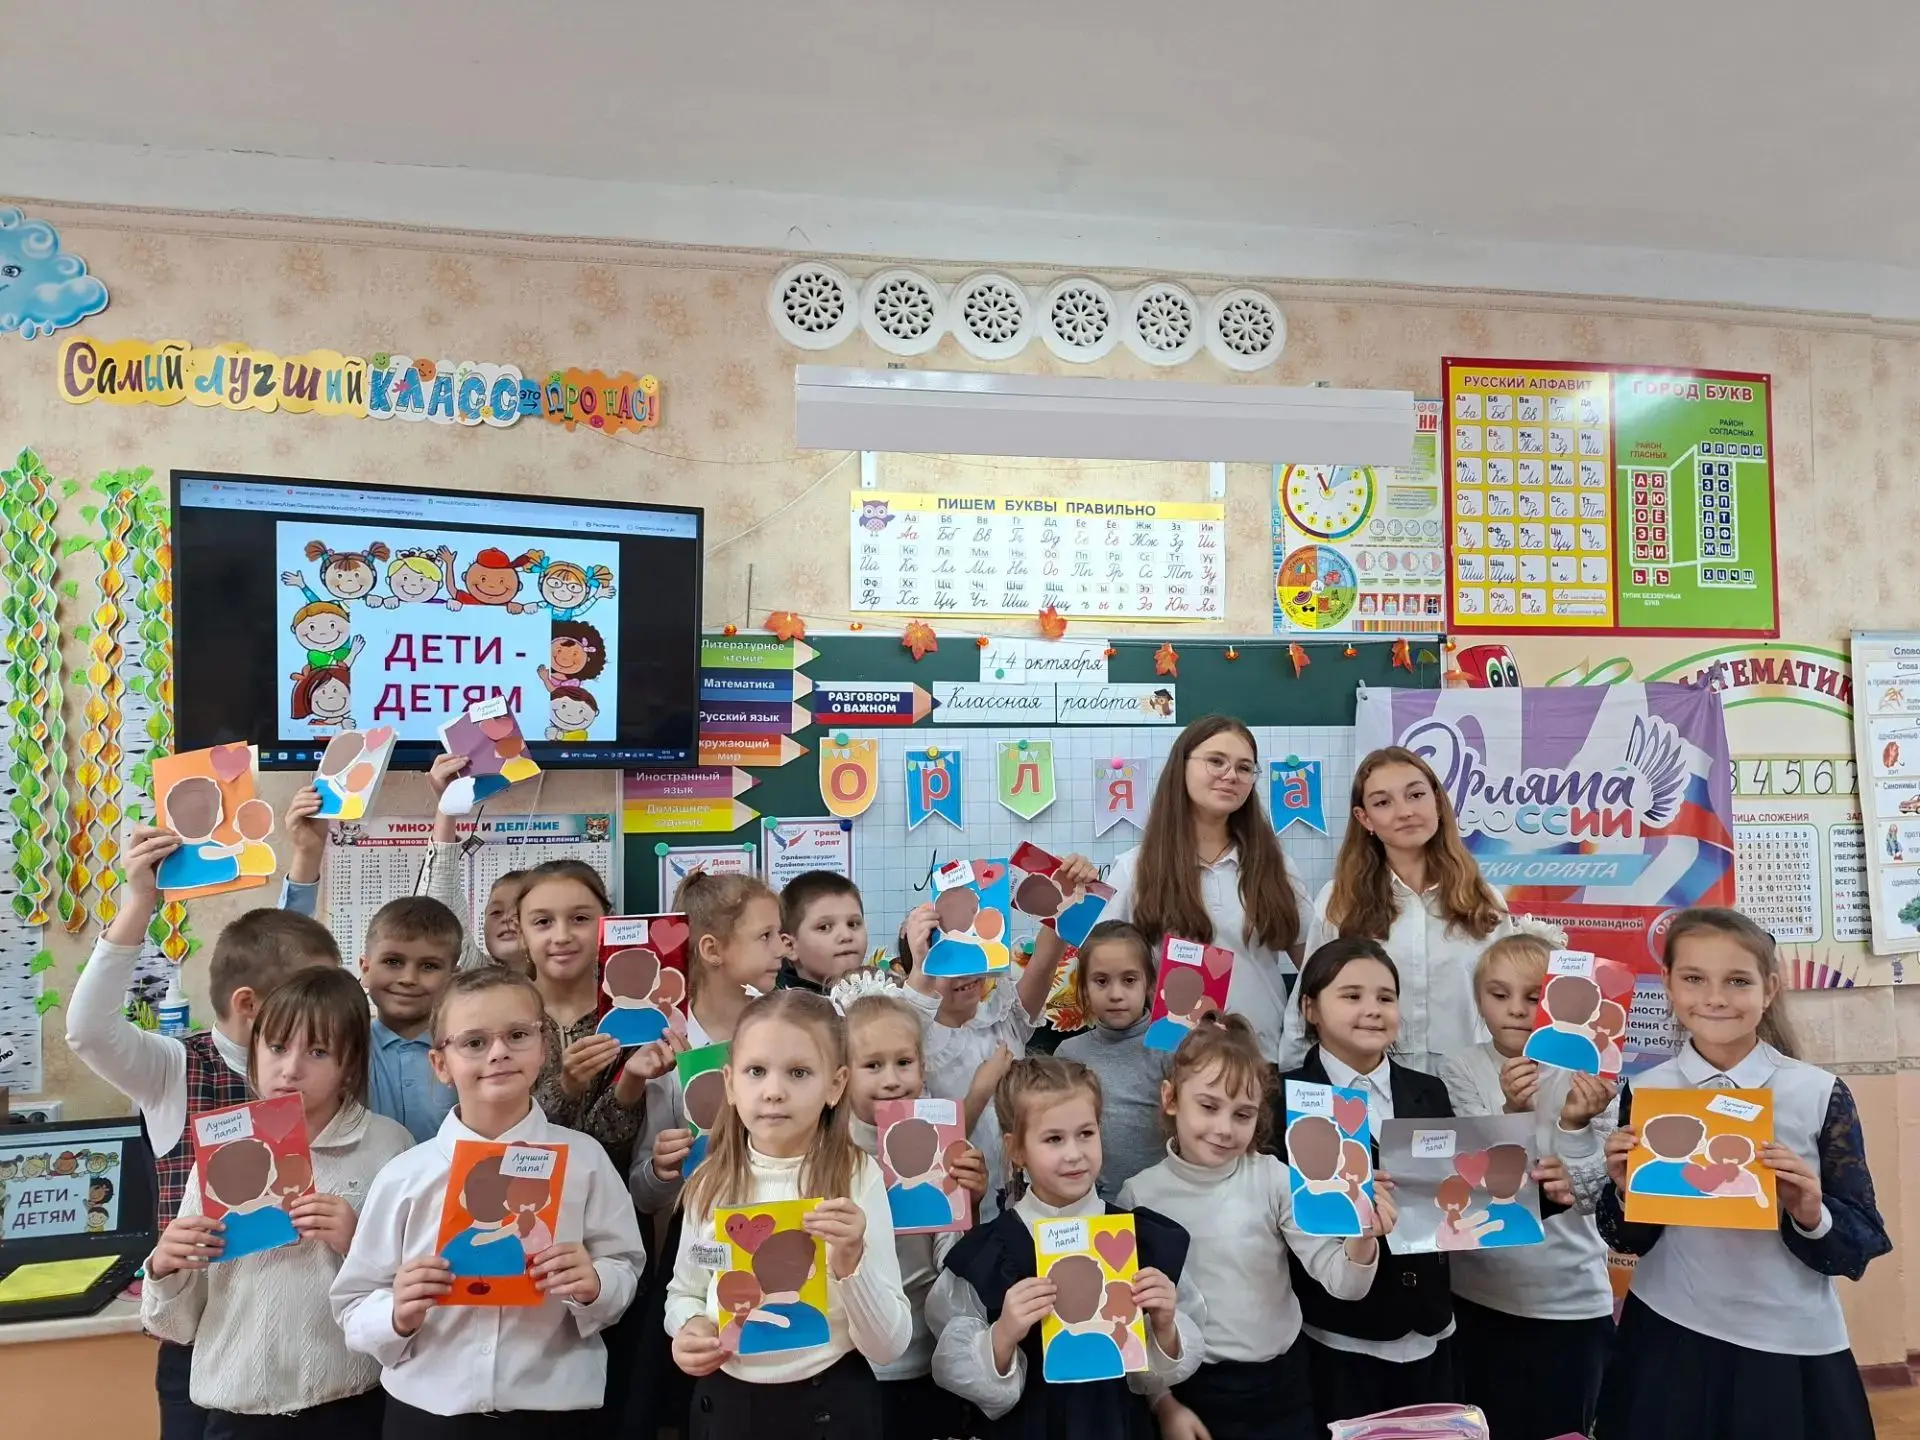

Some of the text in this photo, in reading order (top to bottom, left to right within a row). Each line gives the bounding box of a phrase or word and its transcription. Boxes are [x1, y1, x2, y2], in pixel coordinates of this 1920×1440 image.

[64, 342, 185, 397] Самый
[1464, 375, 1592, 390] РУССКИЙ АЛФАВИТ
[369, 367, 518, 421] КЛАСС
[1634, 382, 1752, 400] ГОРОД БУКВ
[545, 384, 654, 421] ПРО НАС!
[1719, 418, 1743, 427] РАЙОН
[1709, 427, 1754, 436] СОГЛАСНЫХ
[1636, 441, 1662, 450] РАЙОН
[1631, 450, 1667, 459] ГЛАСНЫХ
[938, 498, 1156, 517] ПИШЕМ БУКВЫ ПРАВИЛЬНО
[701, 639, 785, 651] Литературное
[385, 634, 502, 671] ДЕТИ
[723, 655, 763, 663] чтение
[1025, 650, 1104, 678] октября
[704, 679, 775, 689] Математика
[374, 683, 521, 720] ДЕТЯМ
[828, 692, 900, 702] РАЗГОВОРЫ
[946, 686, 1140, 718] Классная работа
[832, 704, 897, 713] О ВАЖНОМ
[699, 711, 780, 723] Русский язык
[699, 739, 770, 750] кружающий
[717, 753, 740, 763] мир
[636, 771, 720, 783] Иностранный
[1753, 760, 1768, 795] 4
[1782, 760, 1801, 794] 5
[1814, 760, 1833, 794] 6
[1883, 782, 1917, 790] Синонимы
[647, 804, 711, 813] Домашнее
[1758, 813, 1810, 822] СЛОЖЕНИЯ
[482, 822, 491, 832] И
[814, 829, 841, 838] Треки
[1524, 862, 1619, 878] ОРЛЯТА
[1578, 919, 1644, 930] командной
[1295, 1088, 1325, 1100] Лучший
[205, 1112, 243, 1133] Лучший
[214, 1123, 242, 1140] папа!
[512, 1153, 549, 1164] Лучший
[516, 1163, 544, 1173] папа!
[18, 1188, 68, 1208] ДЕТИ
[12, 1209, 76, 1230] ДЕТЯМ
[1048, 1223, 1080, 1239] Лучший
[1055, 1236, 1079, 1248] папа!
